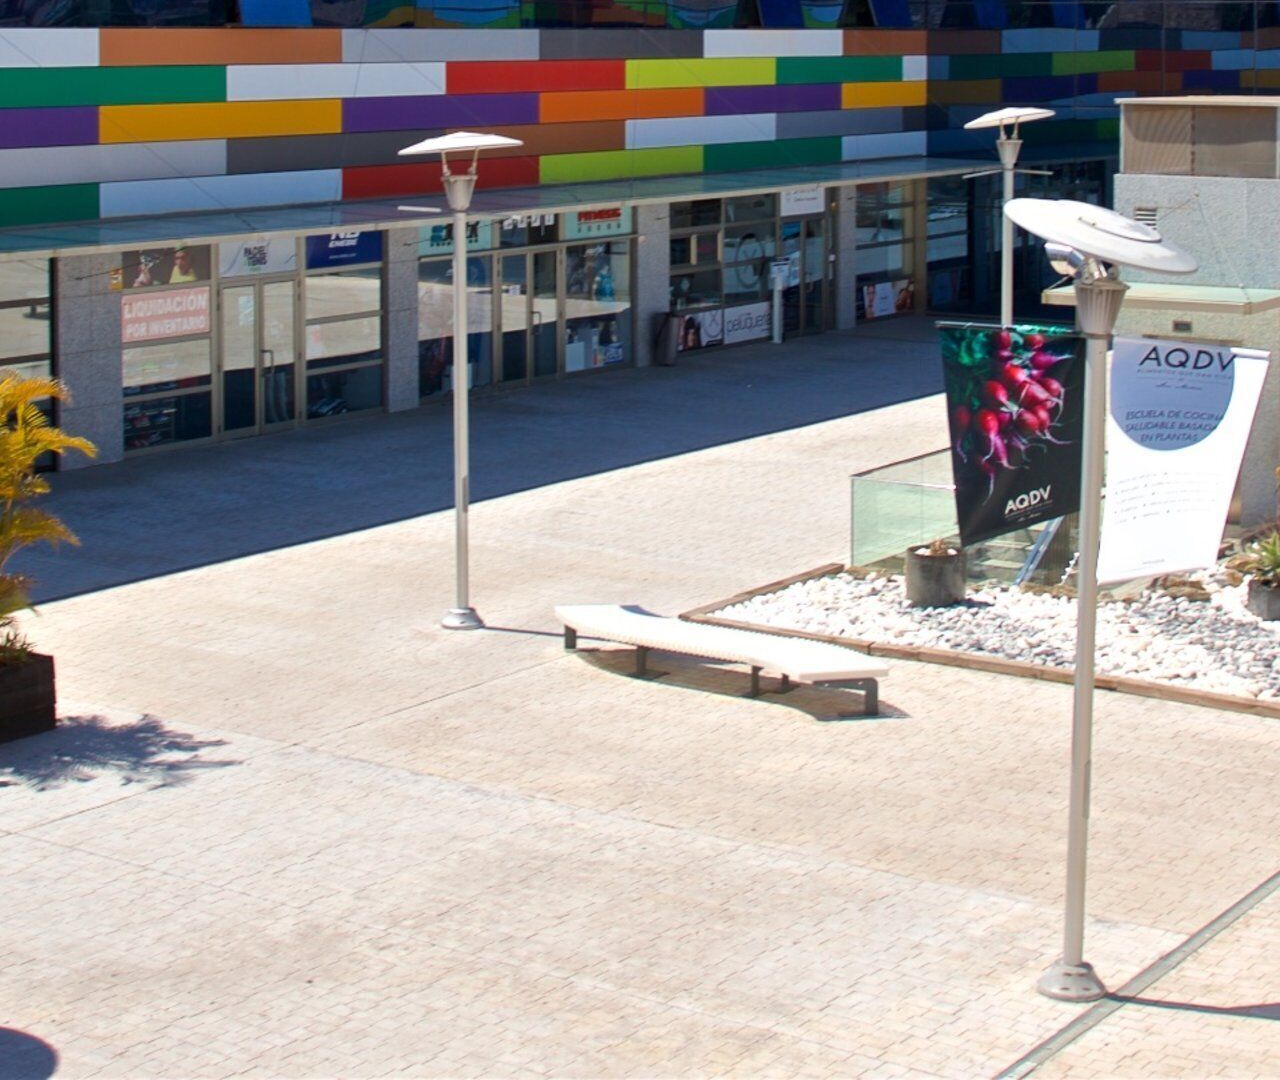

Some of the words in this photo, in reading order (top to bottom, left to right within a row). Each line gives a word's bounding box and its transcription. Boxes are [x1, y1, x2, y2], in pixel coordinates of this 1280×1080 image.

[124, 291, 208, 318] LIQUIDACIÓN
[127, 322, 147, 337] POR
[149, 315, 206, 335] INVENTARIO
[1139, 345, 1237, 371] AQDV
[1126, 410, 1165, 421] ESCUELA
[1168, 410, 1182, 419] DE
[1140, 433, 1154, 442] EN
[1155, 432, 1198, 442] PLANTAS
[1004, 484, 1051, 515] AQDV
